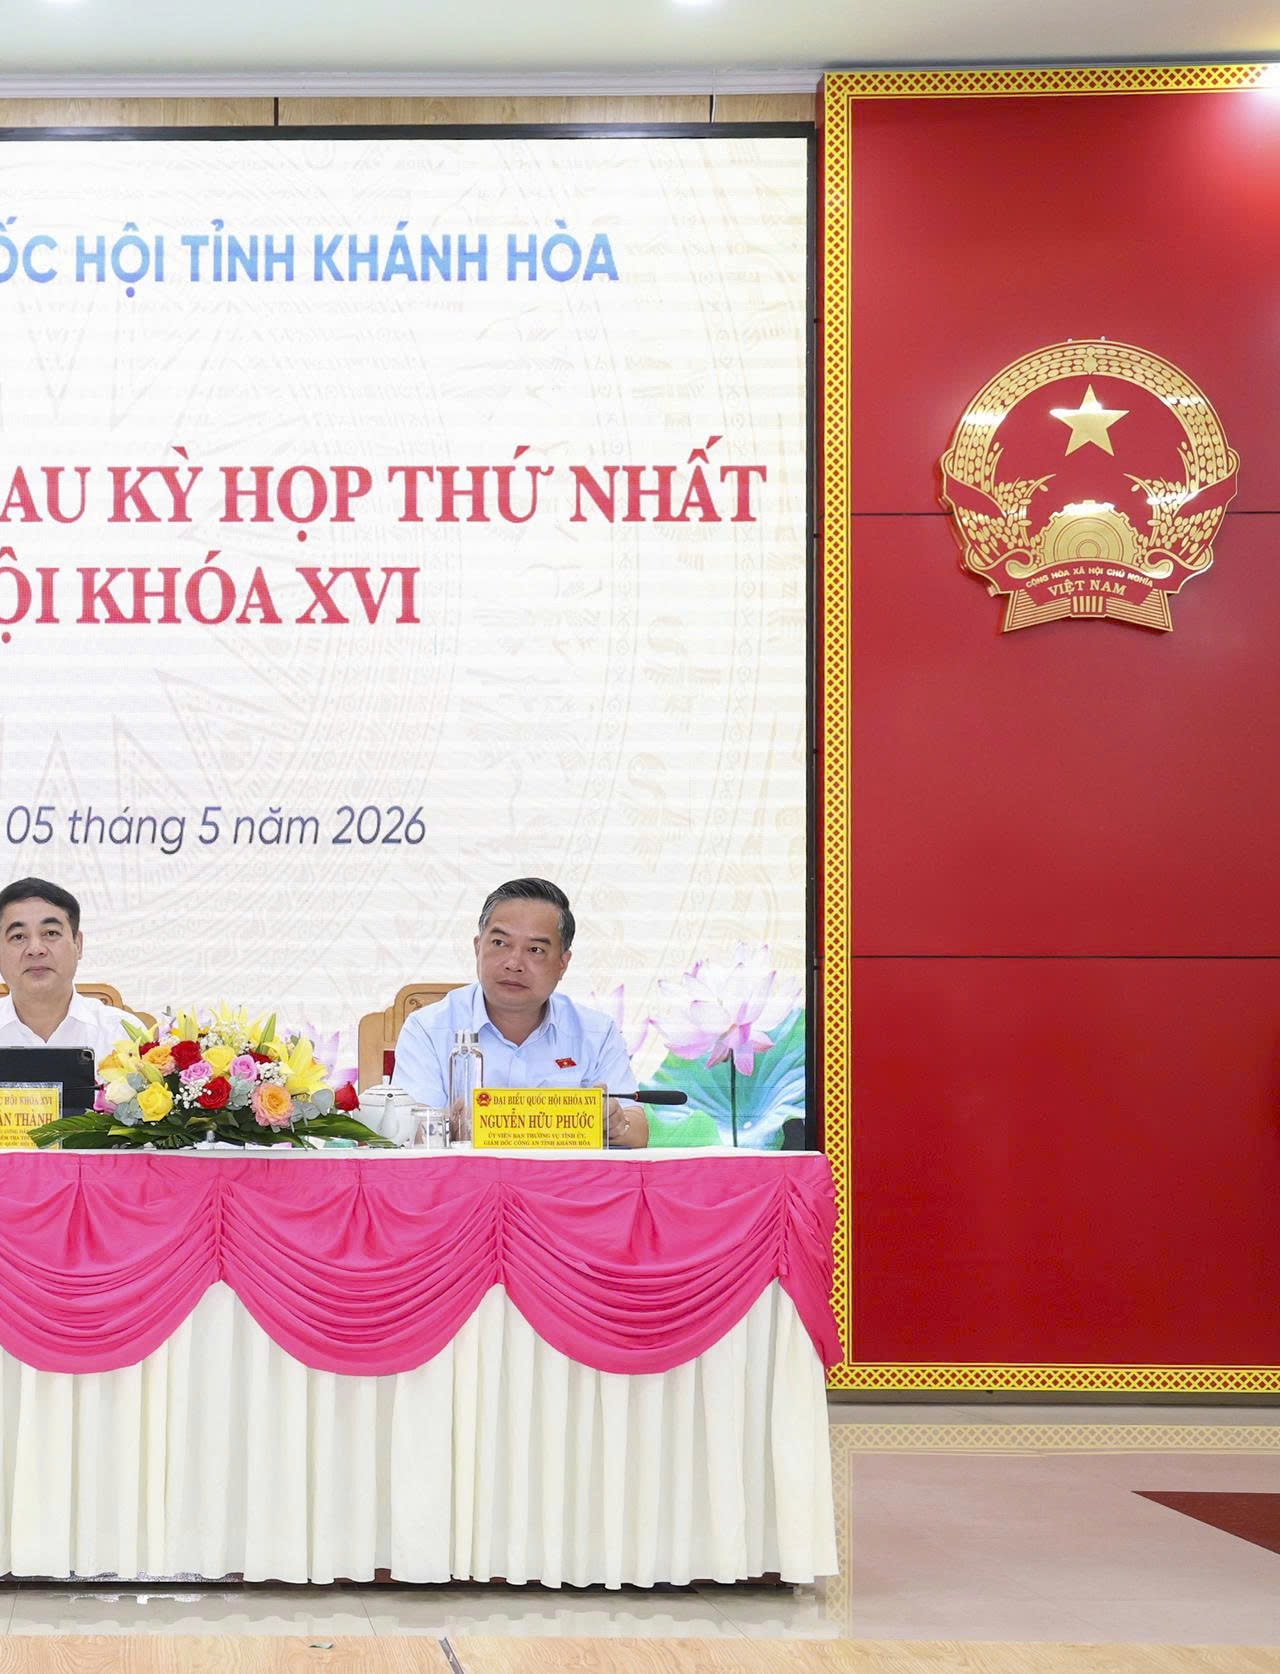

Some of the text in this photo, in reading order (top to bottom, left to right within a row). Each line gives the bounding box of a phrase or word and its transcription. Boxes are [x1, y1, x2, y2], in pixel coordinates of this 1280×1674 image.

[77, 224, 163, 296] HỘI
[183, 220, 293, 281] TỈNH
[315, 222, 487, 281] KHÁNH
[508, 221, 617, 282] HÒA
[112, 448, 201, 521] KỲ
[223, 467, 371, 540] HỌP
[389, 446, 552, 522] THỨ
[572, 437, 766, 521] NHẤT
[1051, 569, 1071, 579] HÒA
[1073, 567, 1086, 575] XÃ
[1088, 567, 1104, 576] HỘI
[1106, 568, 1125, 578] CHỦ
[1127, 572, 1154, 587] NGHĨA
[77, 552, 280, 624] KHÓA
[298, 567, 419, 624] XVI
[1047, 579, 1127, 597] VIỆT NAM
[7, 806, 55, 845] 05
[69, 806, 185, 855] tháng
[199, 806, 222, 845] 5
[234, 807, 318, 845] năm
[332, 806, 425, 845] 2026
[41, 1096, 53, 1105] XVI
[493, 1092, 596, 1107] ĐẠI BIỂU QUỐC HỘI KHÓA XVI
[480, 1108, 595, 1129] NGUYỄN HỮU PHƯỚC
